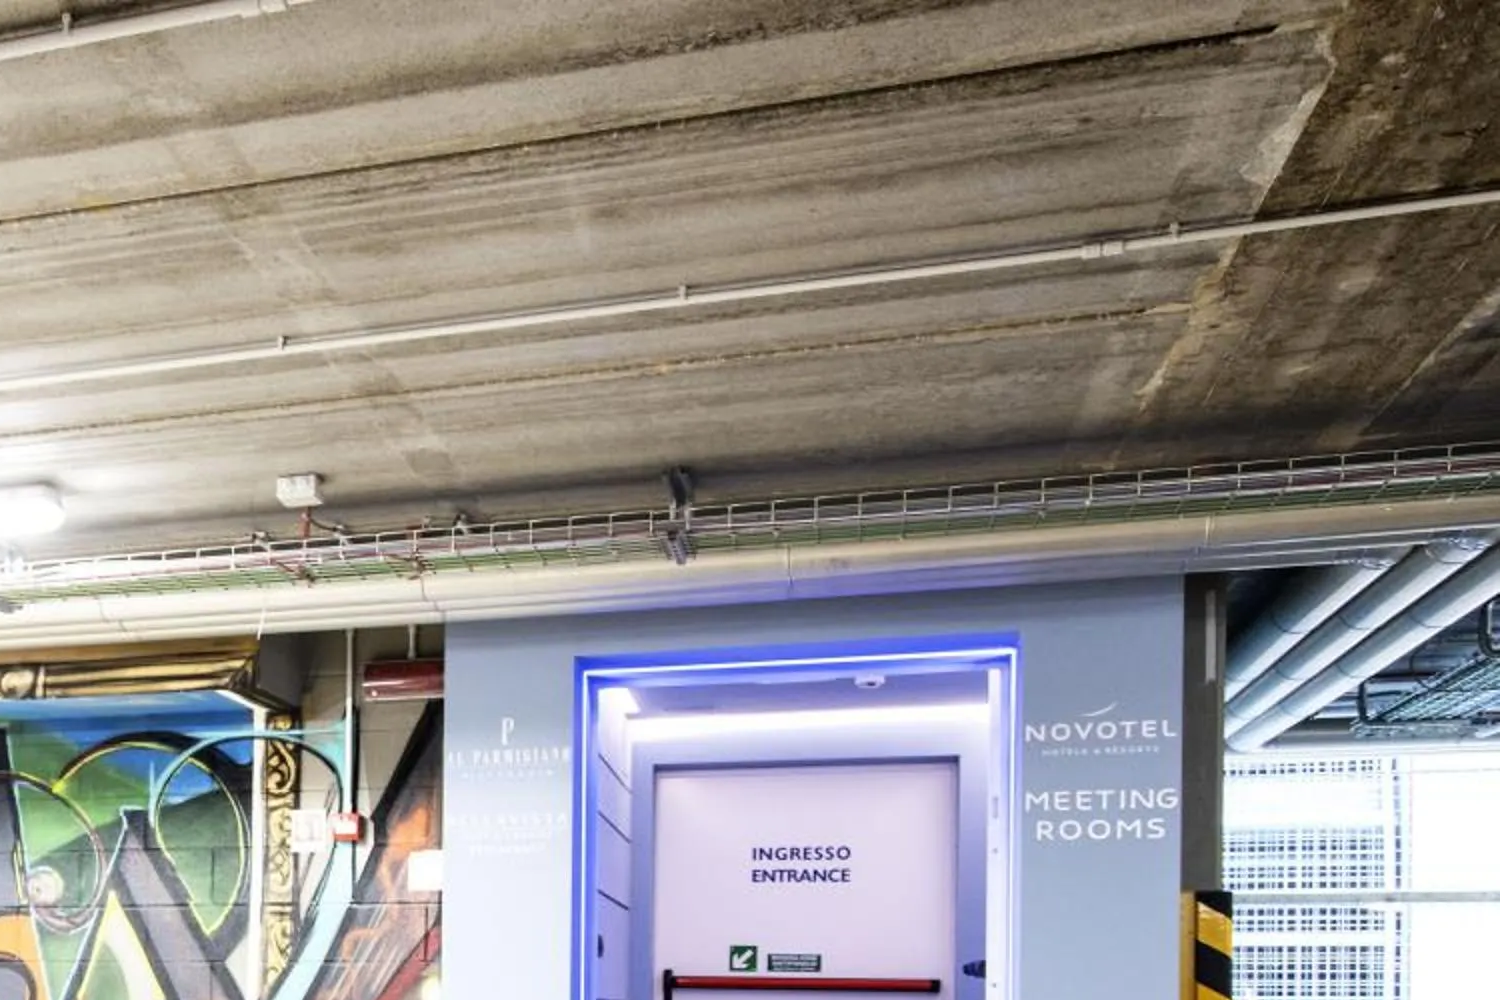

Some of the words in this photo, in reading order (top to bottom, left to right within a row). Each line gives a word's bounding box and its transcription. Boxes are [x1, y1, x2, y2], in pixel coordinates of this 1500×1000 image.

[1025, 719, 1178, 742] NOVOTEL
[1025, 787, 1179, 813] MEETING
[1036, 818, 1167, 842] ROOMS
[751, 845, 851, 861] INGRESSO
[751, 868, 852, 883] ENTRANCE
